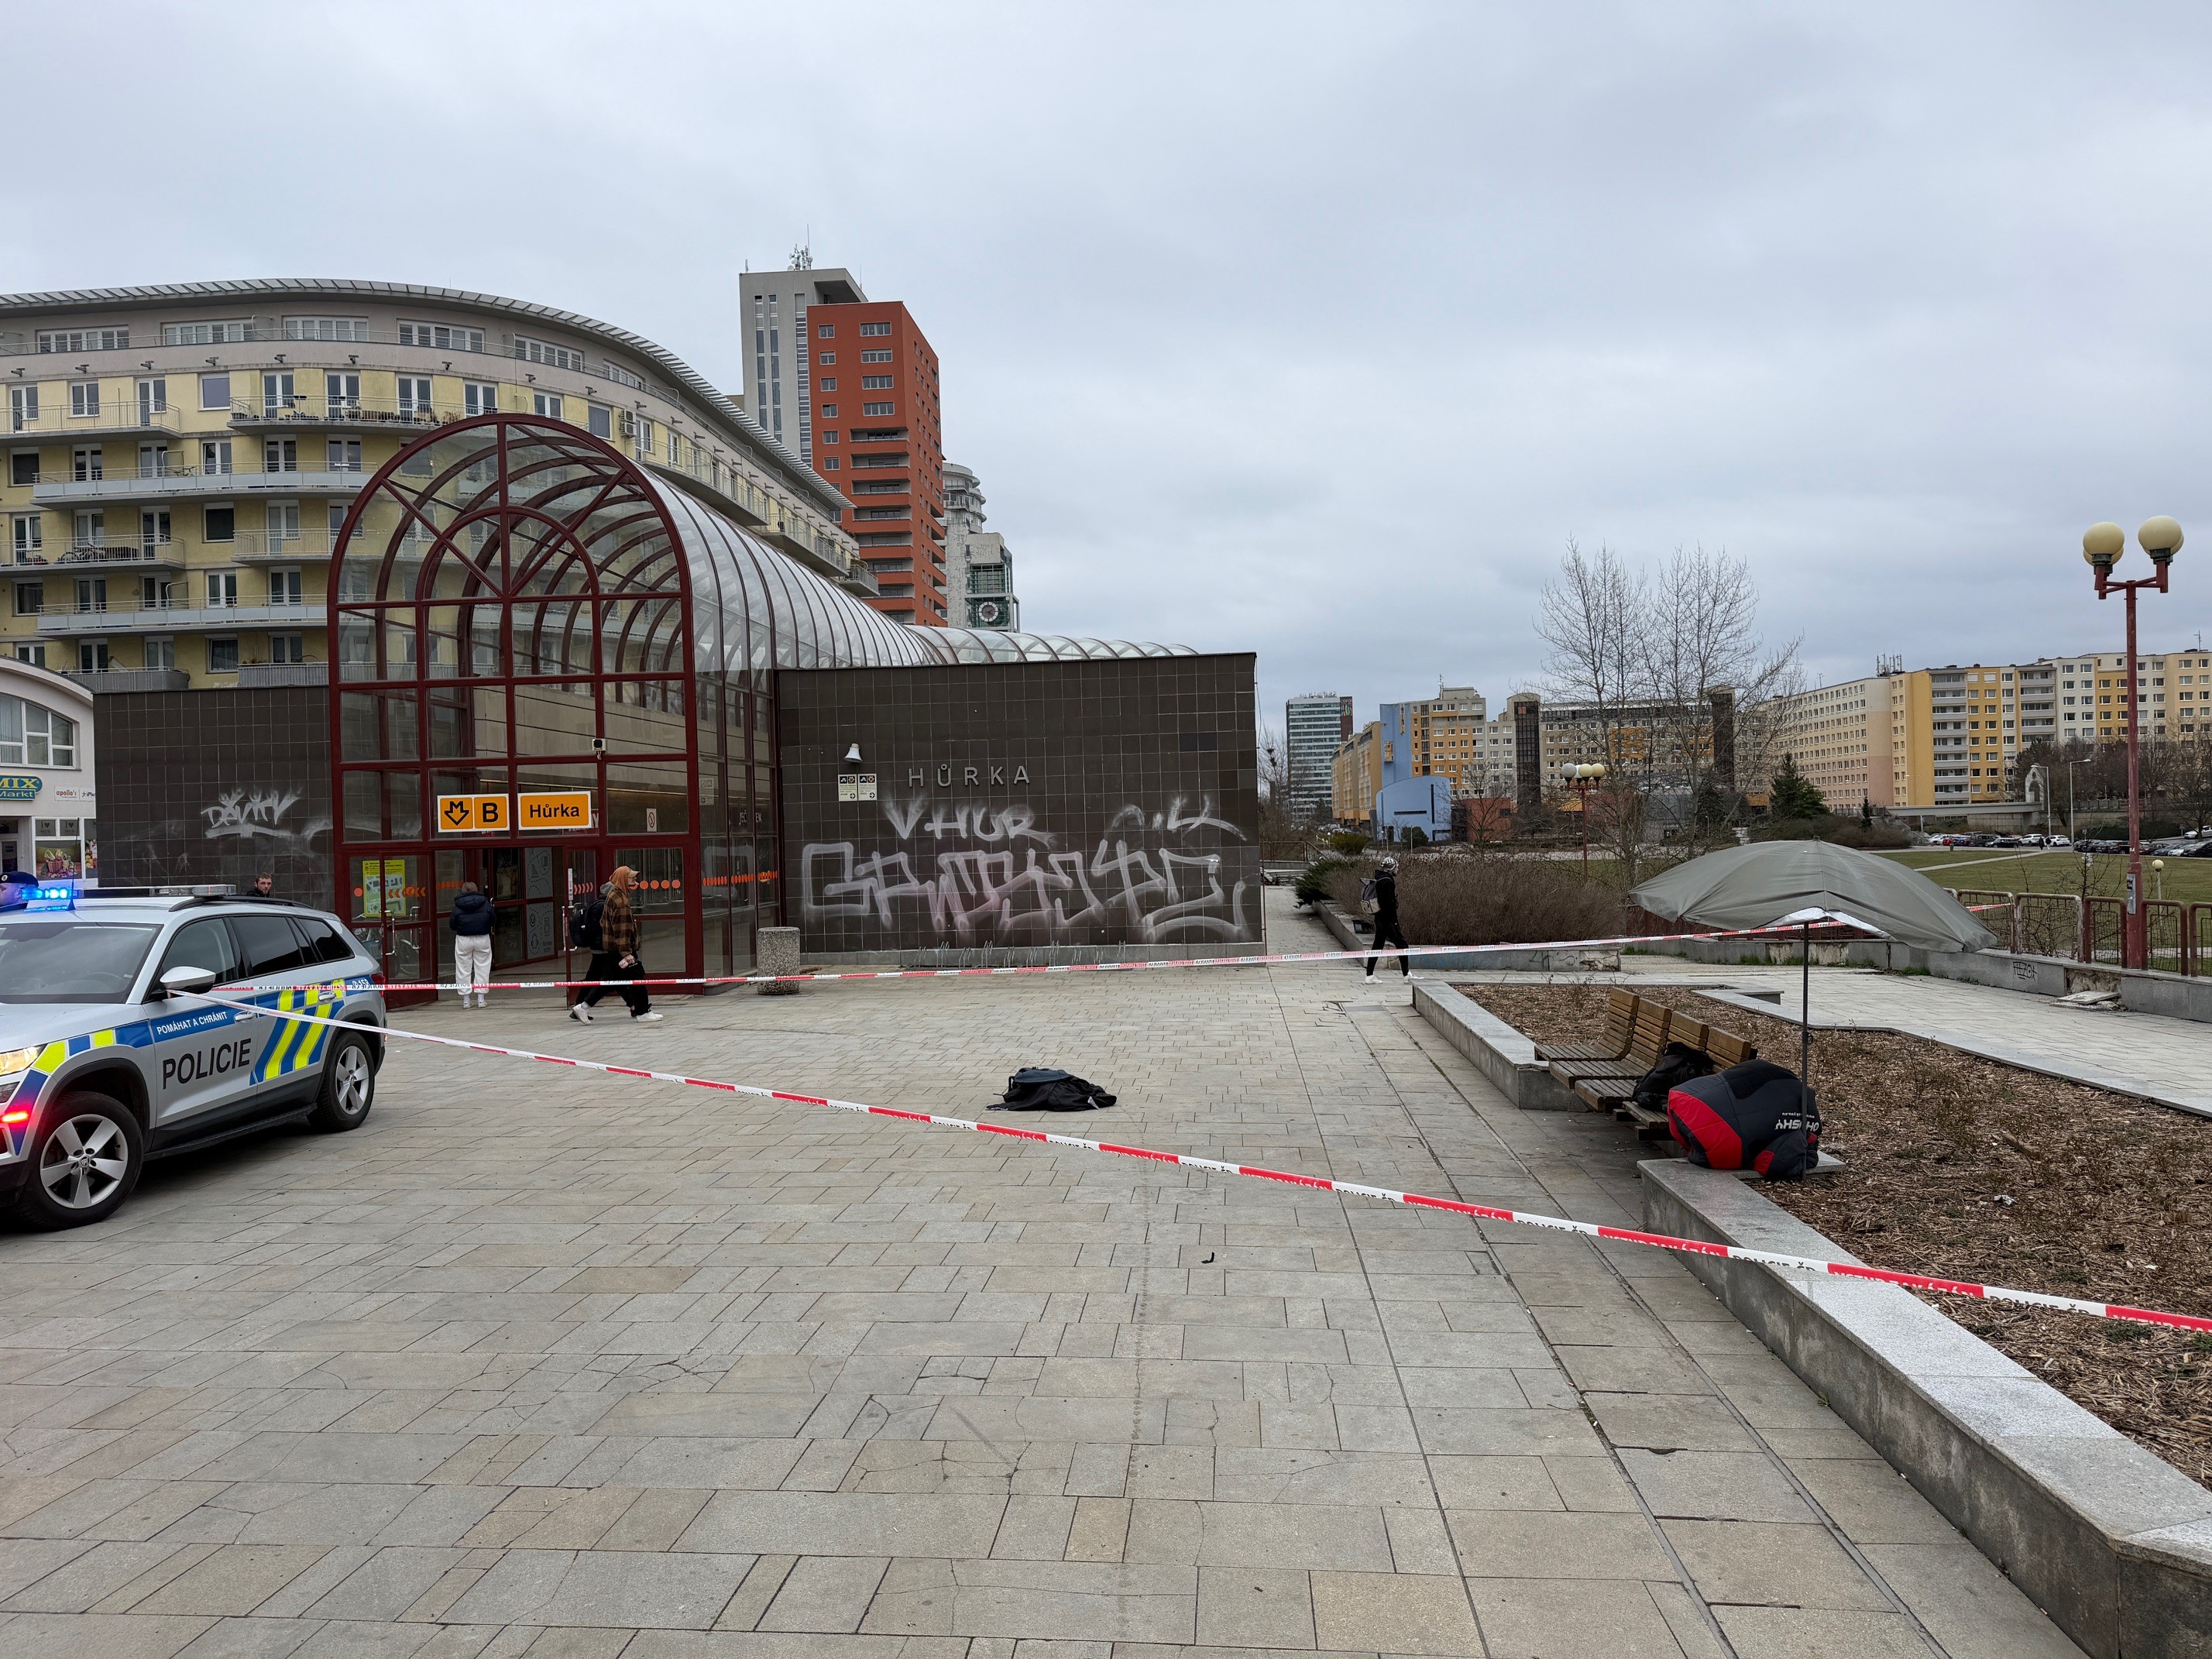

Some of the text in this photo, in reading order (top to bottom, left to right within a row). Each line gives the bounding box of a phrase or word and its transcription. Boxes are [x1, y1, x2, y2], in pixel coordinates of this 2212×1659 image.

[908, 764, 1030, 787] HŮRKA
[482, 802, 499, 823] B
[530, 804, 580, 819] Hůrka
[156, 1011, 228, 1035] POMÁHAT A CHRÁNIT
[163, 1039, 252, 1090] POLICIE
